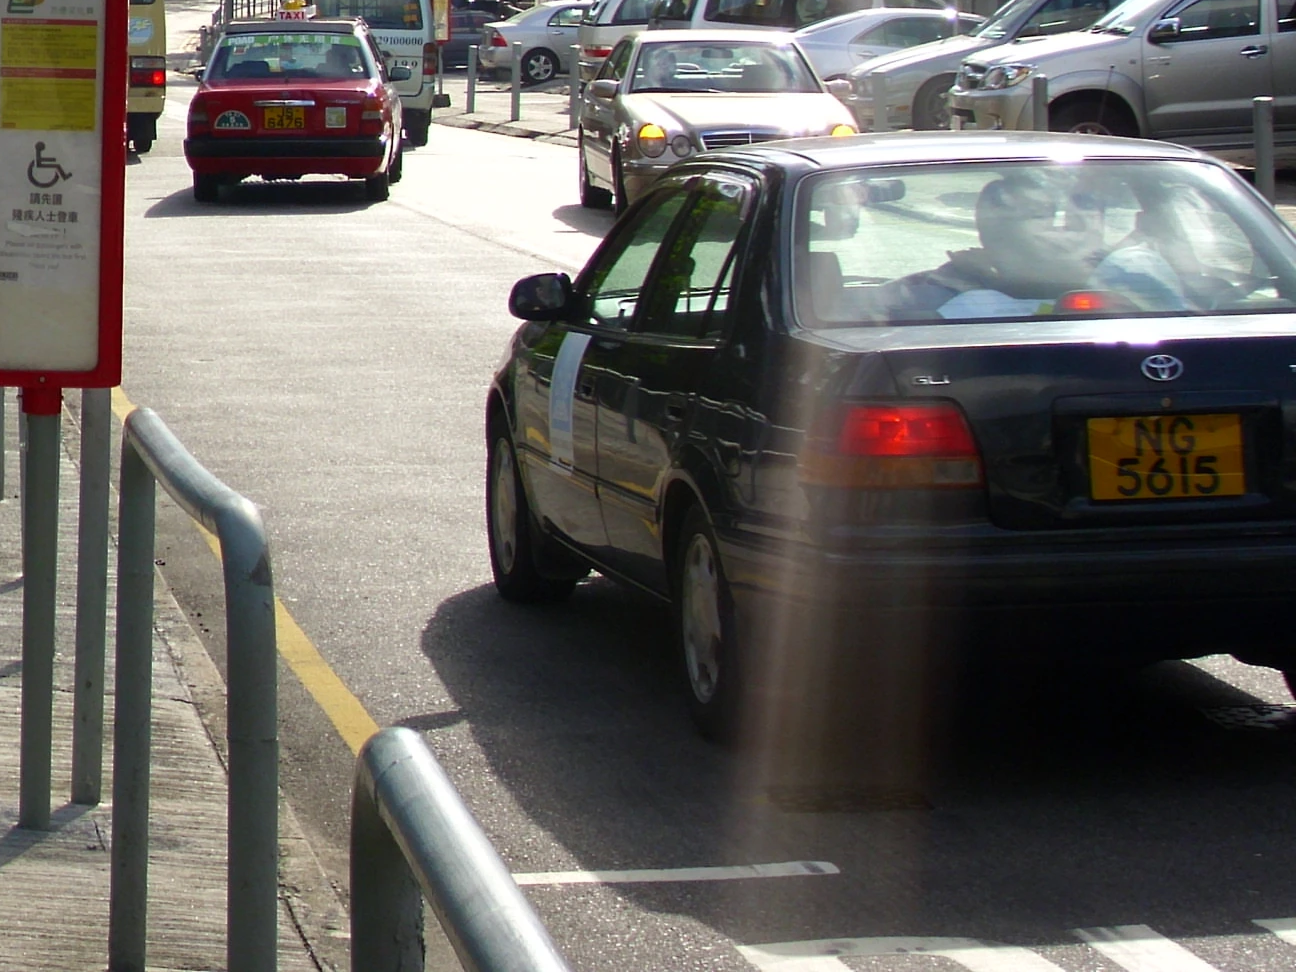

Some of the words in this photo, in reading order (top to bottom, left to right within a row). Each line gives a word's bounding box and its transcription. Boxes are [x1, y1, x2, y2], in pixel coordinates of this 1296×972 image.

[278, 10, 305, 20] TAXI
[1134, 416, 1195, 456] NG
[1116, 456, 1220, 496] 5615
